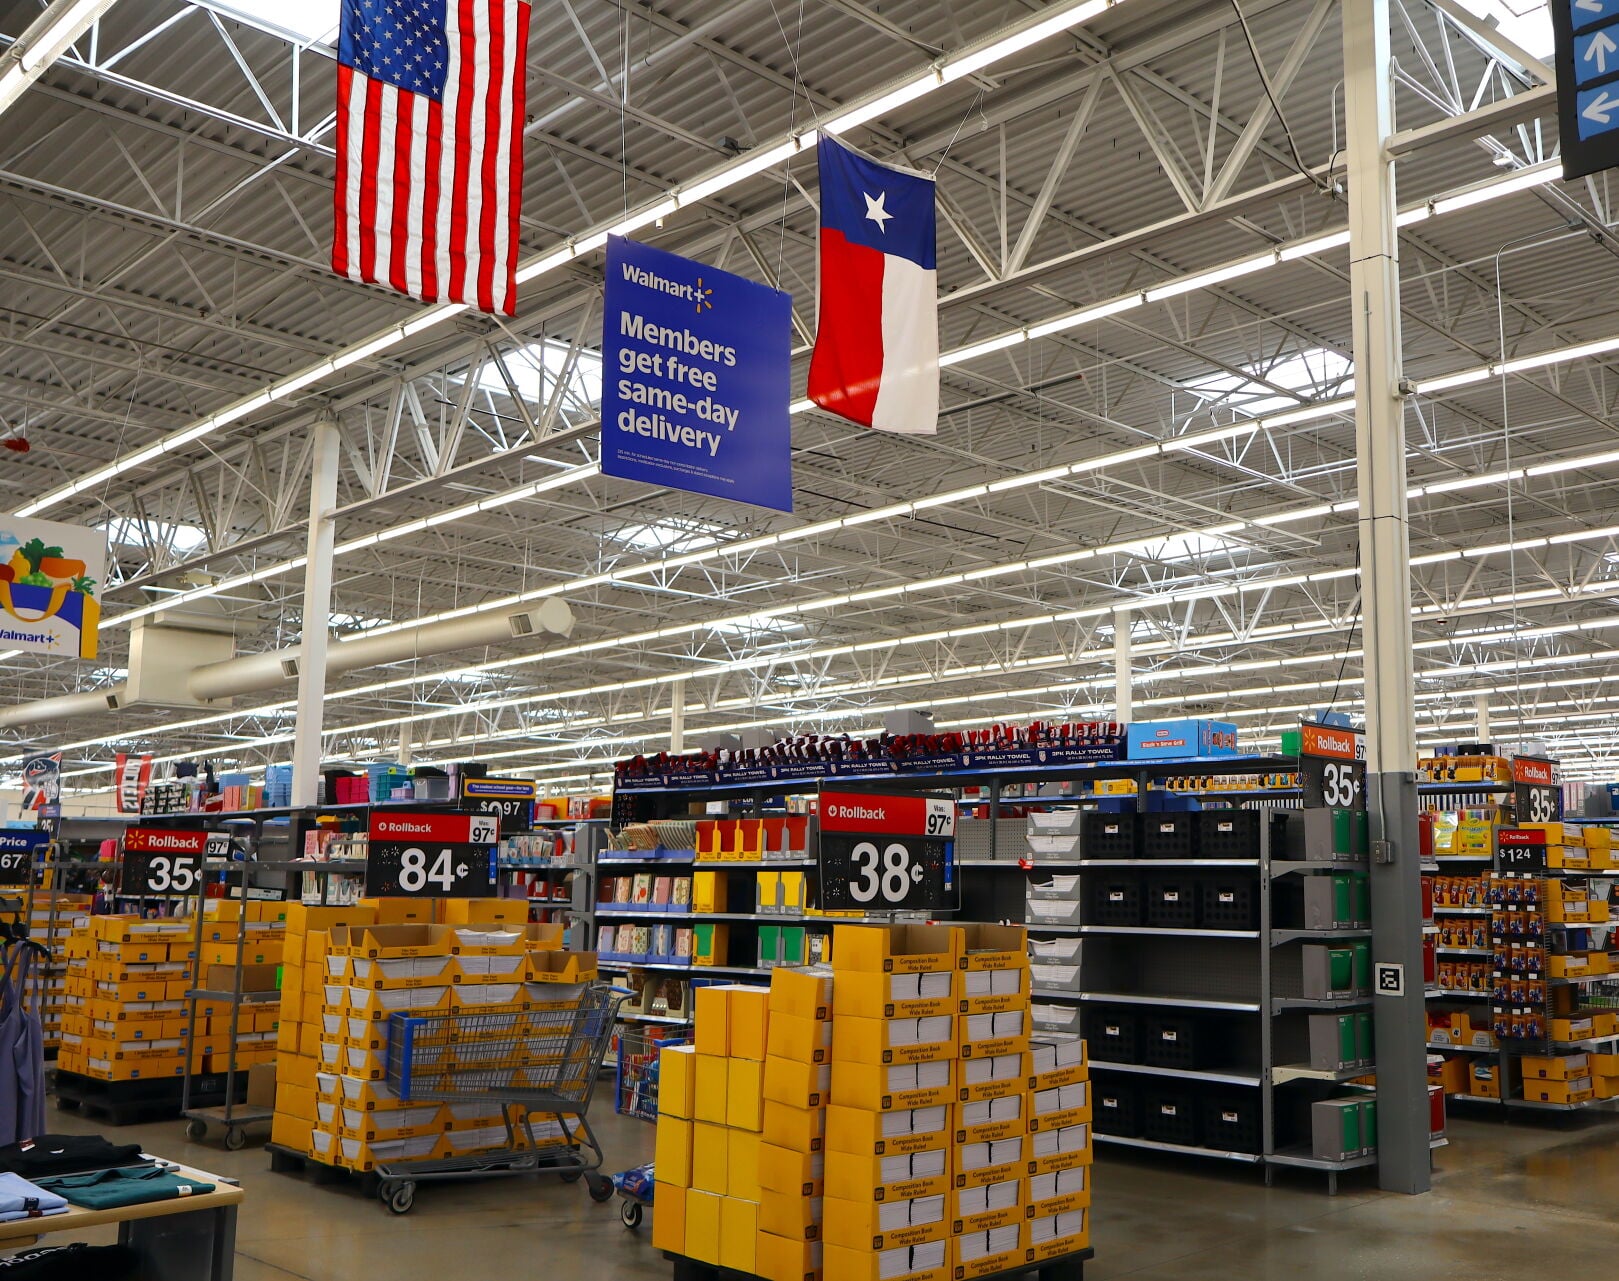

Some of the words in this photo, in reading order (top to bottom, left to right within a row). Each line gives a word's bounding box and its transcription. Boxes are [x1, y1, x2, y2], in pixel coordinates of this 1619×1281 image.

[620, 311, 736, 366] Members
[619, 347, 662, 377] get
[666, 356, 718, 392] free
[618, 379, 740, 432] same-day
[617, 409, 721, 456] delivery
[0, 629, 54, 644] almart+
[1318, 736, 1350, 752] Rollback
[1525, 766, 1548, 779] Rollback
[1324, 763, 1360, 806] 35¢
[1530, 788, 1555, 822] 35¢
[840, 806, 885, 820] Rollback
[389, 822, 432, 833] Rollback
[0, 837, 27, 846] Price
[148, 835, 199, 849] Rollback
[399, 848, 469, 892] 84¢
[849, 842, 924, 902] 38¢
[1042, 1072, 1064, 1080] Composition
[970, 1215, 995, 1223] Composition
[891, 1231, 920, 1239] Composition
[1040, 1243, 1063, 1251] Composition
[971, 1258, 996, 1268] Composition
